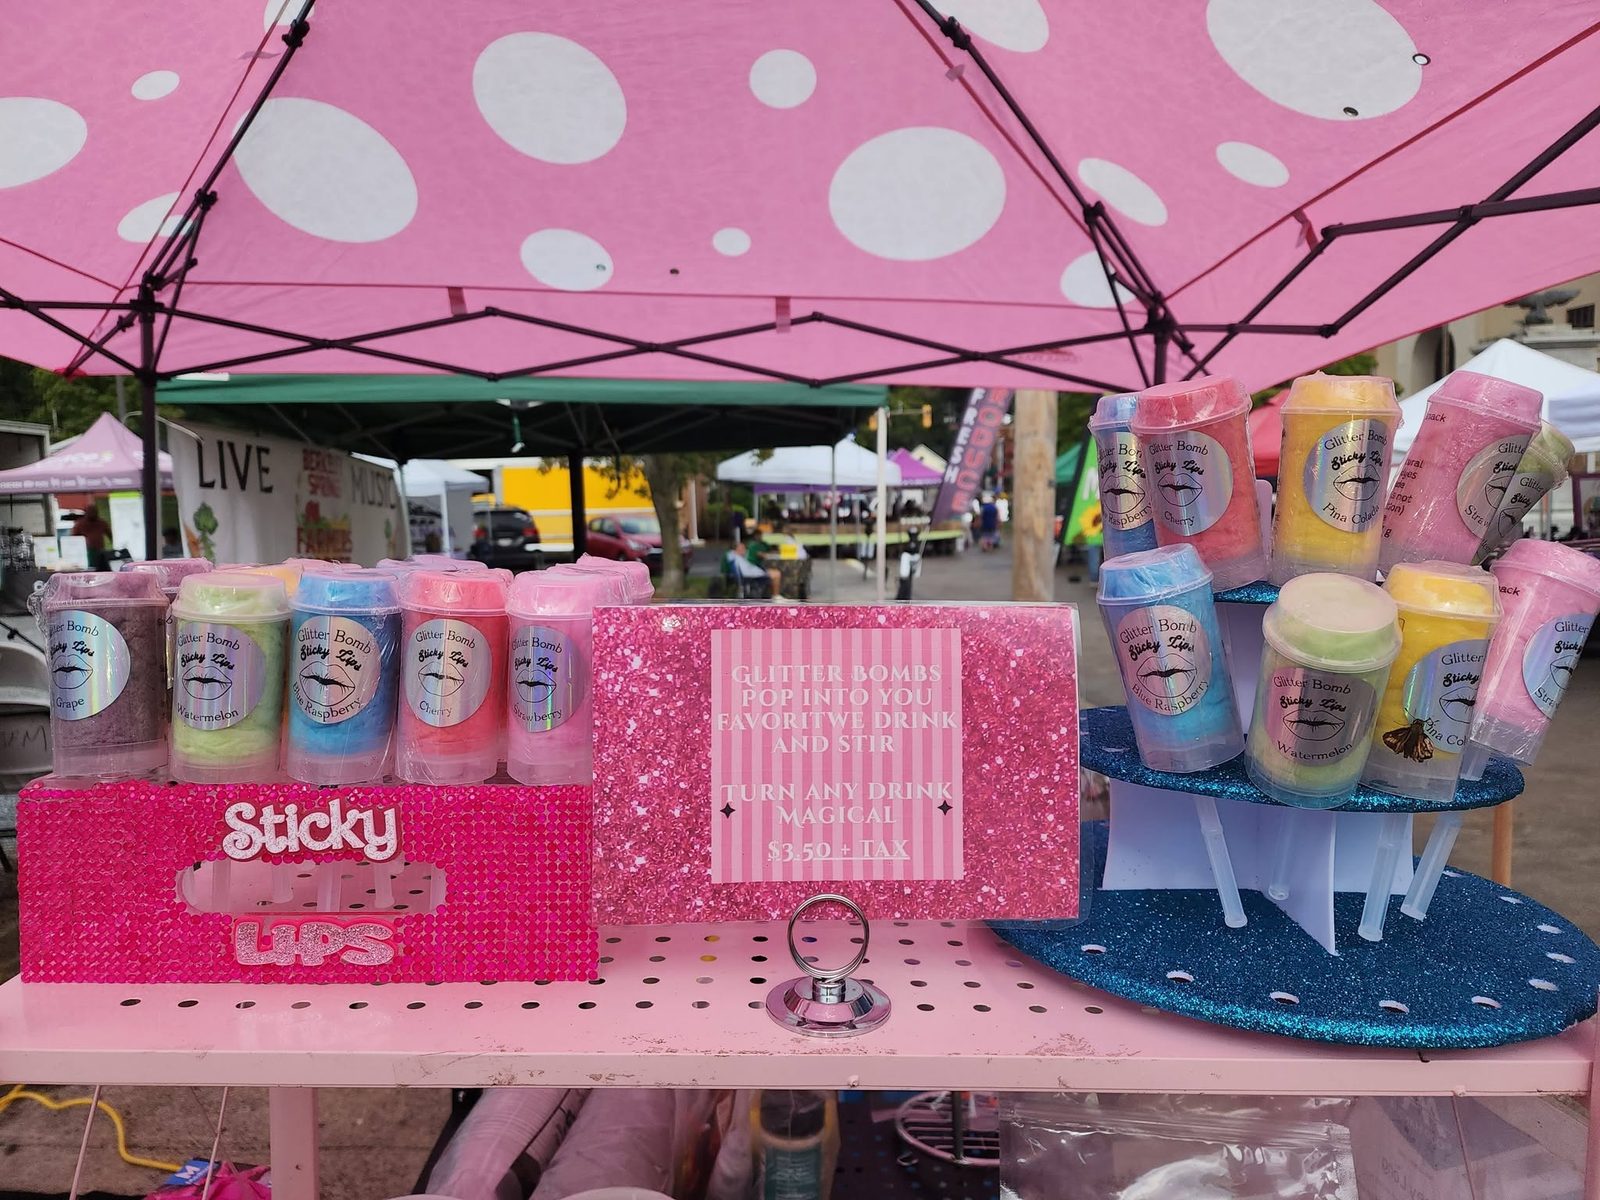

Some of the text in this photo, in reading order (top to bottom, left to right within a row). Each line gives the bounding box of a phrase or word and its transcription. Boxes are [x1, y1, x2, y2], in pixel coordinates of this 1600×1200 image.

[951, 386, 1011, 513] RODUCE
[1149, 440, 1208, 456] Glitter Bomb
[1324, 432, 1365, 451] Glitter
[1498, 442, 1526, 455] Glitte
[197, 438, 273, 494] LIVE
[1154, 459, 1205, 476] Sticky Lips
[1331, 451, 1366, 471] Sticky
[1164, 510, 1195, 526] Cherry
[1498, 586, 1520, 596] ack
[67, 620, 99, 637] Bomb
[1119, 618, 1197, 644] Glitter Bomb
[1554, 621, 1590, 634] Glitter
[72, 640, 95, 657] Lips
[177, 632, 240, 651] Glitter Bomb
[297, 626, 372, 655] Glitter Bomb
[415, 629, 476, 649] Glitter Bomb
[531, 637, 563, 655] Bomb
[1127, 634, 1195, 662] Sticky Lips
[180, 650, 235, 670] Sticky Lips
[300, 644, 363, 672] Sticky Lips
[418, 647, 469, 668] Sticky Lips
[536, 656, 559, 673] Lips
[1441, 652, 1483, 666] Glitter
[731, 663, 943, 686] GLITTER BOMBS
[1443, 671, 1481, 687] Sticky
[1273, 676, 1351, 695] Glitter Bomb
[55, 696, 85, 712] Grape
[741, 687, 933, 707] POP INTO YOU
[1131, 680, 1209, 713] Blue Raspberry
[1280, 695, 1347, 712] Sticky Lips
[177, 702, 240, 722] Watermelon
[304, 696, 363, 723] Raspberry
[419, 699, 453, 718] Cherry
[716, 710, 959, 731] FAVORITWE DRINK
[771, 734, 896, 753] AND STIR
[1277, 740, 1353, 761] Watermelon
[1446, 734, 1468, 747] Col
[719, 781, 954, 802] TURN ANY DRINK
[775, 805, 898, 828] MAGICAL
[222, 798, 398, 861] Sticky
[767, 839, 831, 861] $3.50
[858, 838, 912, 859] TAX
